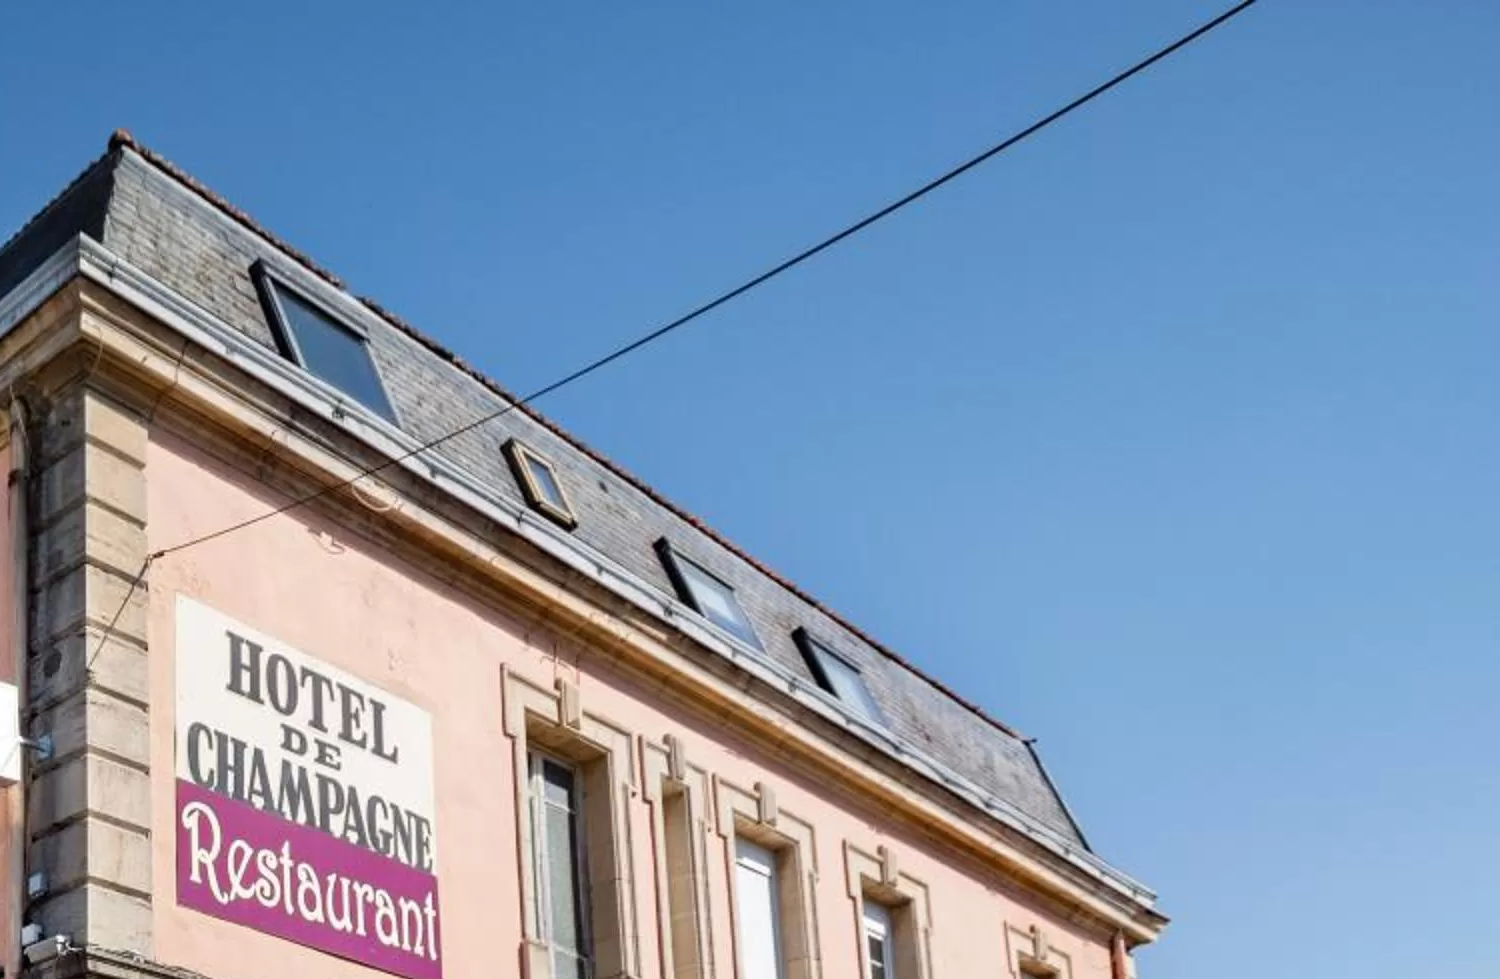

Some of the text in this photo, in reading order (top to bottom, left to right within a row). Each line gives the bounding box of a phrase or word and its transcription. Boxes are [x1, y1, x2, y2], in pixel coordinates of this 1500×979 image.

[225, 629, 399, 765] HOTEL
[280, 722, 341, 771] DE
[187, 721, 433, 872] CHAMPAGNE
[181, 800, 438, 962] Restaurant
